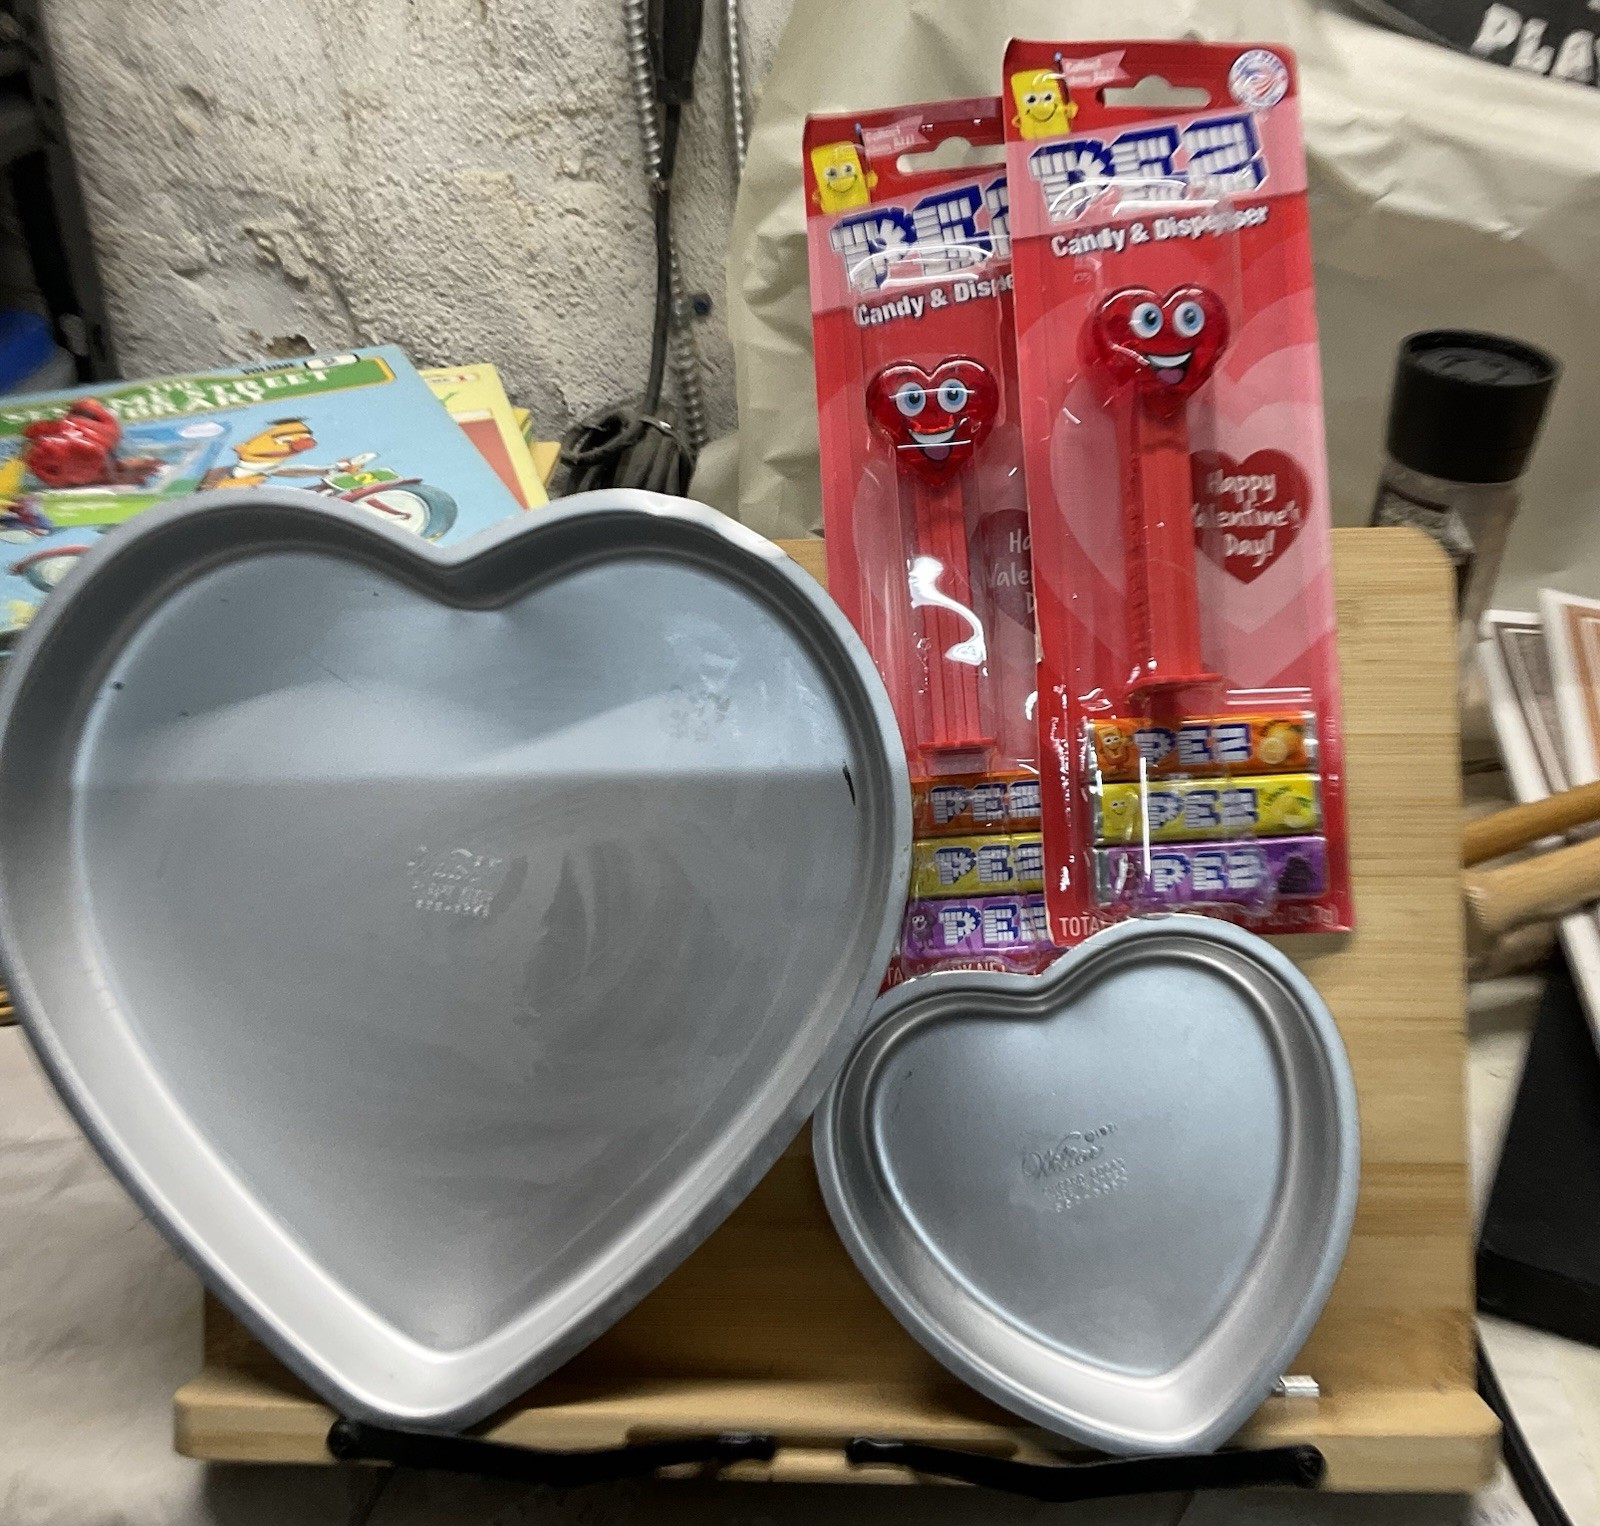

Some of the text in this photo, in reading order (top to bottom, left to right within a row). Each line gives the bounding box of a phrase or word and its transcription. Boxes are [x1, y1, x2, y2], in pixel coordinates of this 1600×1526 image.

[1470, 2, 1600, 86] PLA
[1029, 112, 1269, 222] PEZ
[1051, 206, 1269, 258] Candy & Dispenser
[857, 294, 924, 326] Candy
[930, 287, 949, 309] &
[1205, 468, 1277, 507] Happy
[1133, 723, 1252, 767] PEZ
[1147, 787, 1259, 831] PEZ
[1150, 850, 1265, 893] PEZ
